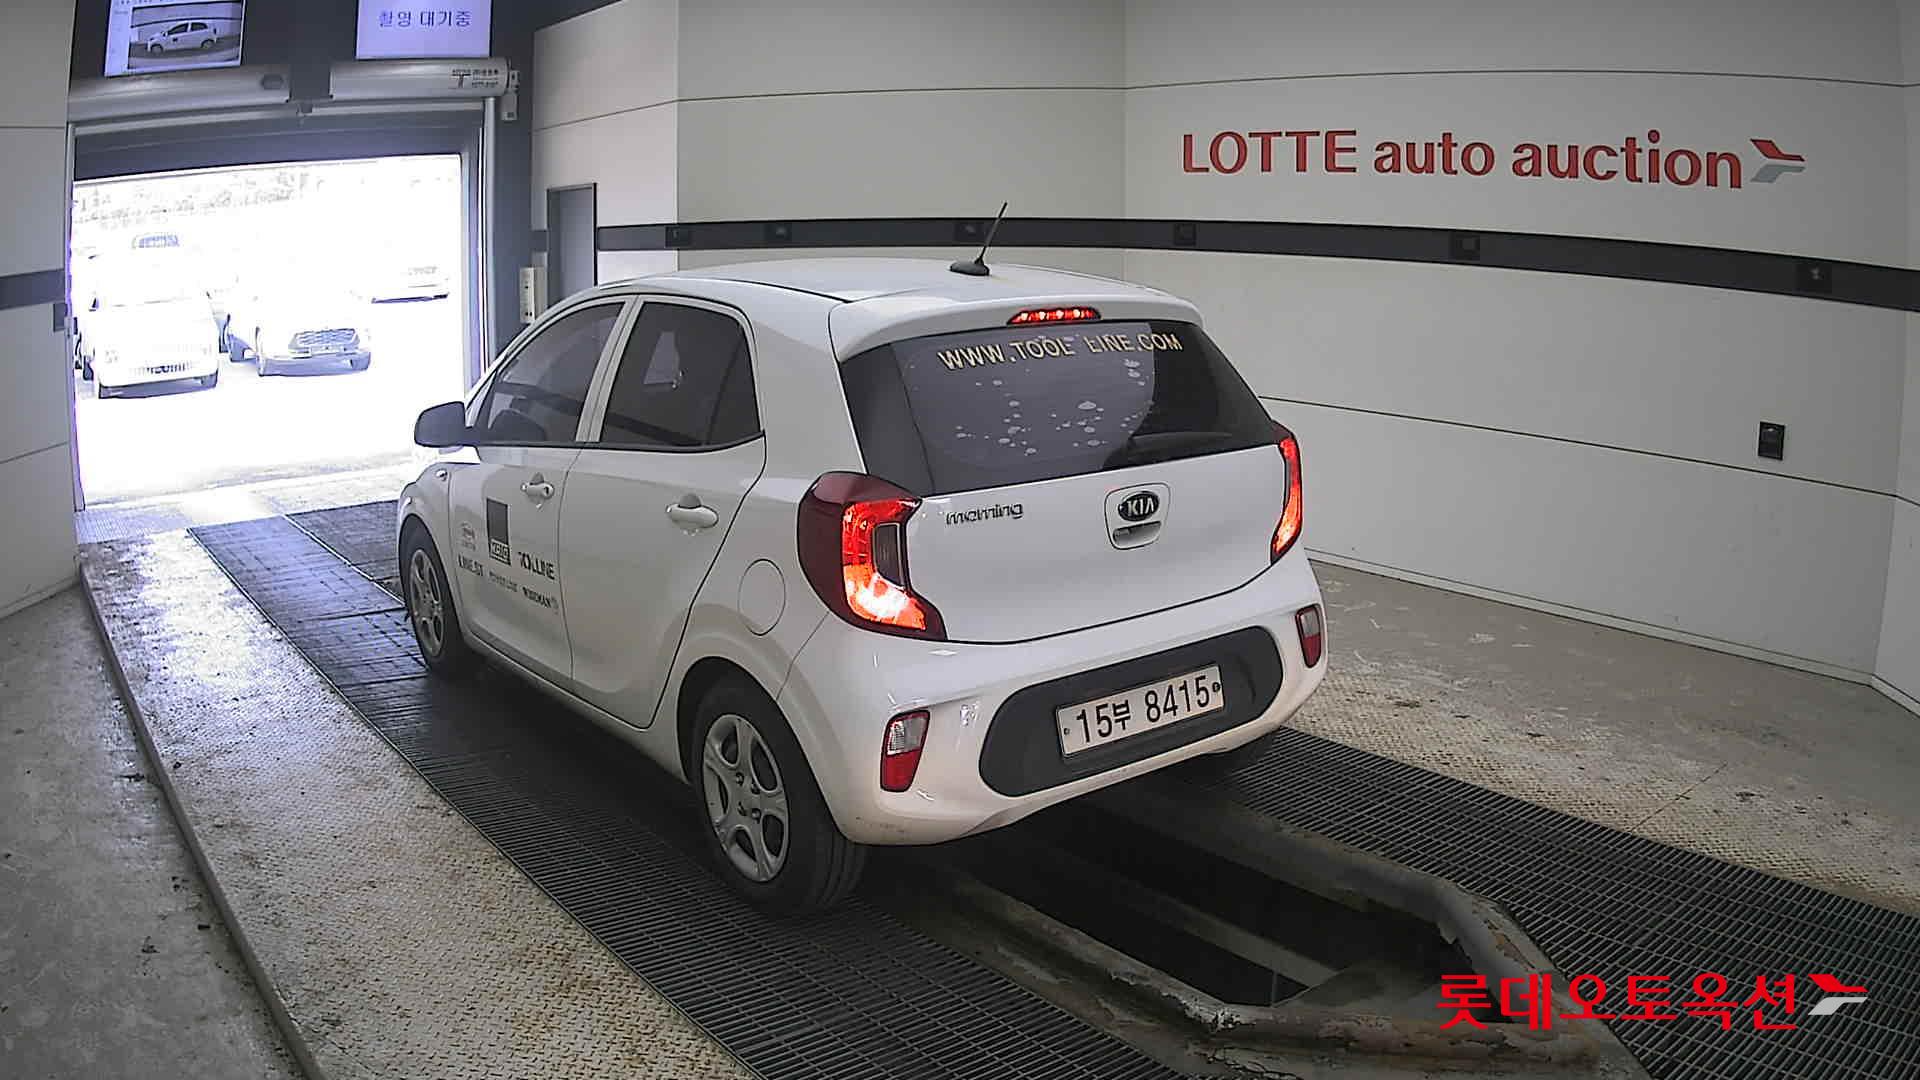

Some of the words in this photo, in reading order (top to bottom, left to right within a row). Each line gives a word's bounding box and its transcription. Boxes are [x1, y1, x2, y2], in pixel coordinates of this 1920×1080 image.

[420, 10, 471, 28] 대기중
[1183, 129, 1358, 174] LOTTE
[1374, 131, 1495, 176] auto
[1511, 129, 1742, 189] auction
[1076, 699, 1131, 743] 15부
[1144, 675, 1210, 723] 8415
